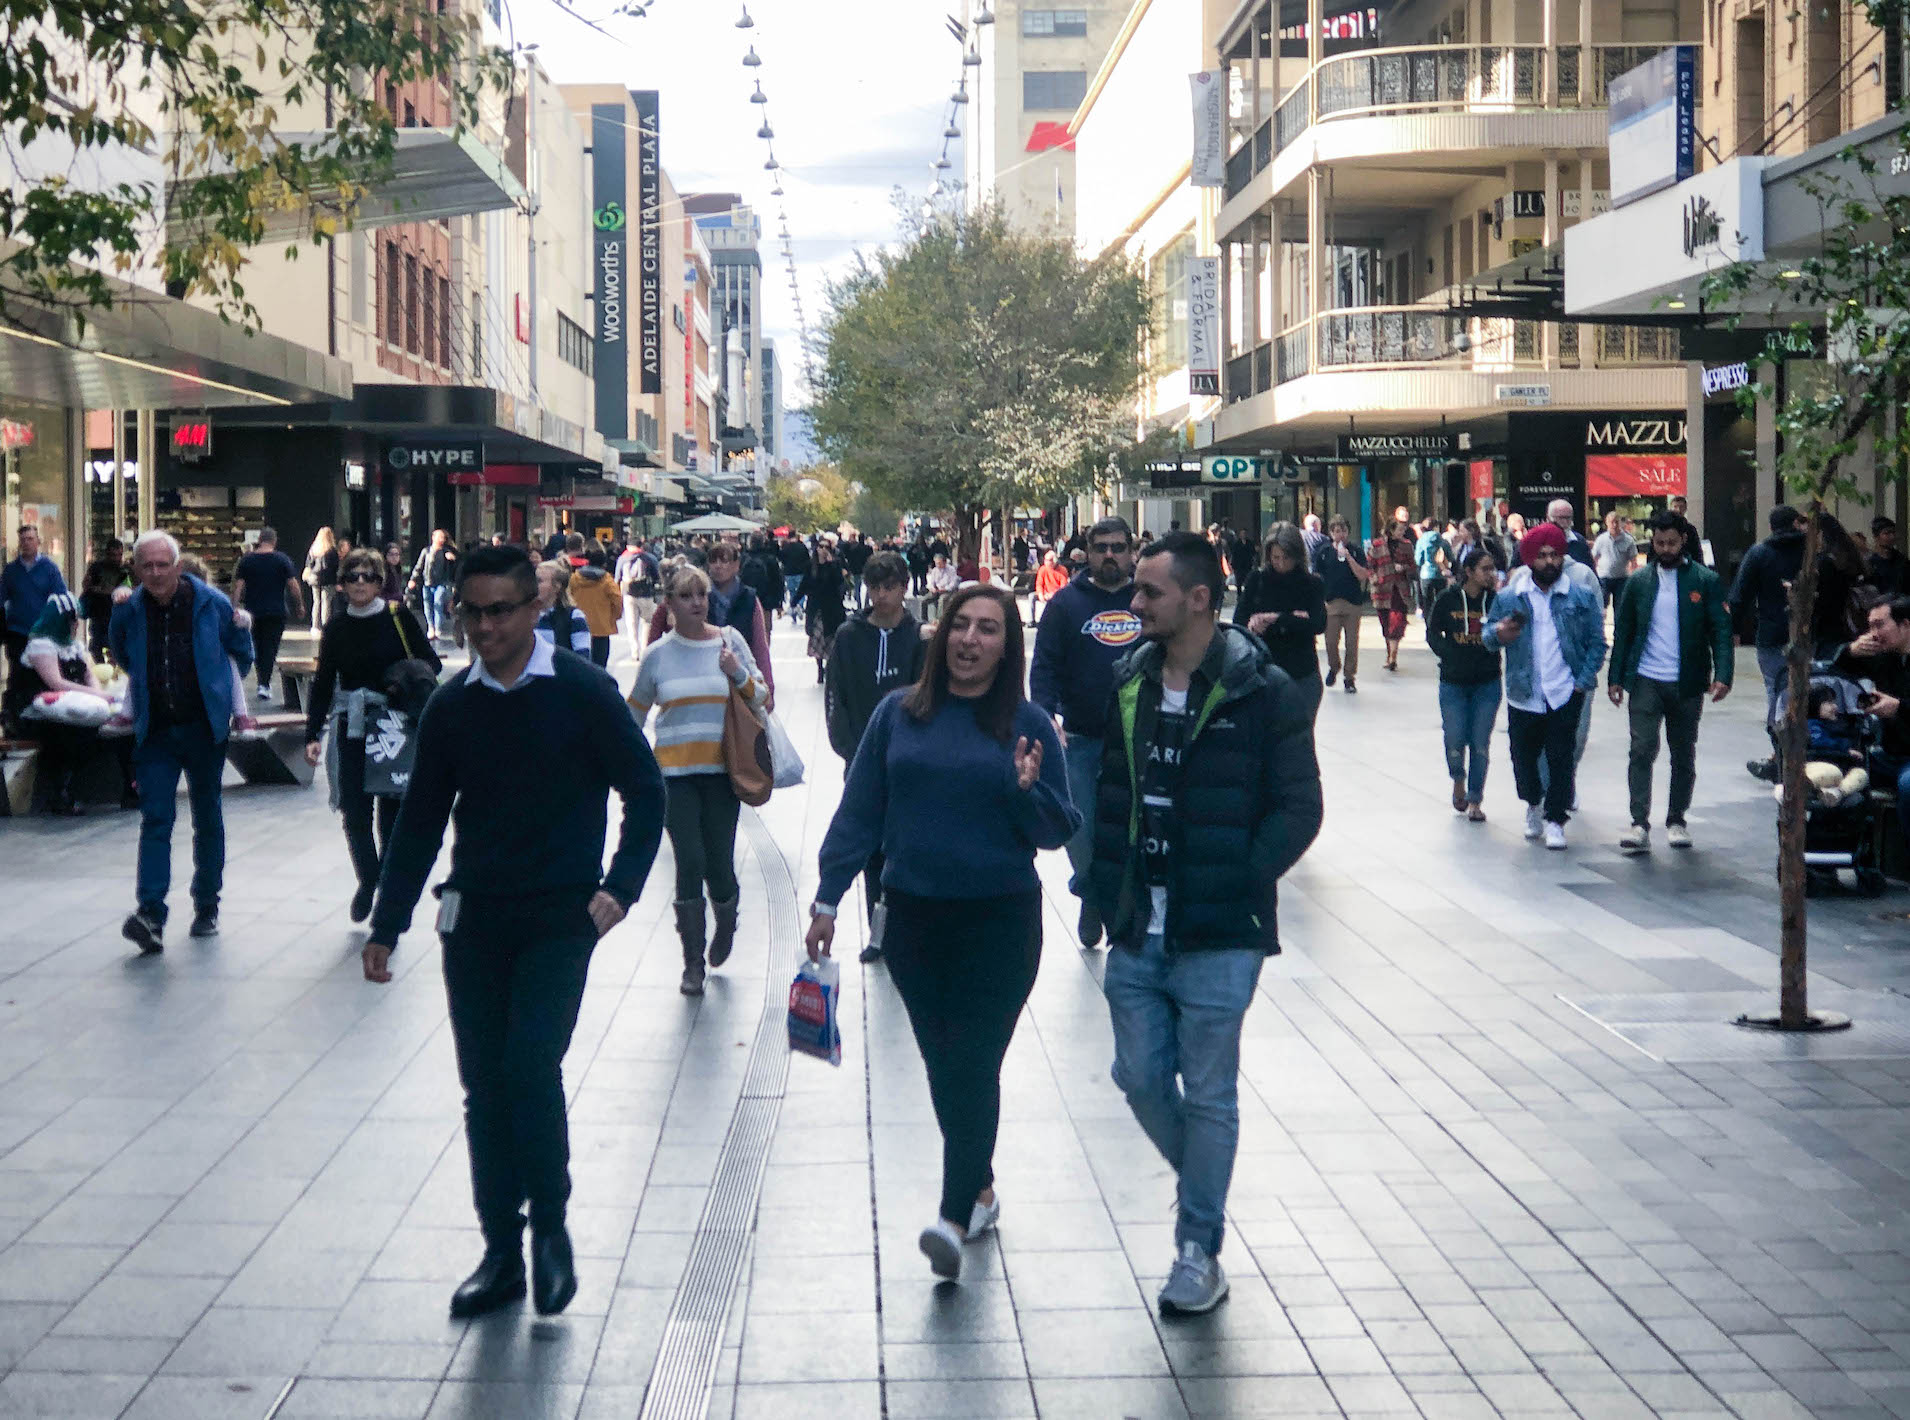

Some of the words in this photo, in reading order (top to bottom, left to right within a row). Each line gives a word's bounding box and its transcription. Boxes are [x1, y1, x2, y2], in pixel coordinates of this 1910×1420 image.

[1681, 72, 1691, 99] For
[642, 114, 657, 175] PLAZA
[1681, 105, 1690, 154] Lease
[643, 181, 657, 272] CENTRAL
[603, 241, 620, 343] Woolworths
[1203, 261, 1215, 321] BRIDAL
[643, 278, 657, 374] ADELAIDE
[1192, 293, 1204, 365] FORMAL
[1586, 421, 1687, 445] MAZZU
[411, 450, 475, 466] HYPE
[1212, 459, 1299, 479] OPTUS
[1639, 469, 1681, 483] SALE
[1518, 486, 1575, 494] FOREVERMARK
[1091, 621, 1142, 632] Dickies
